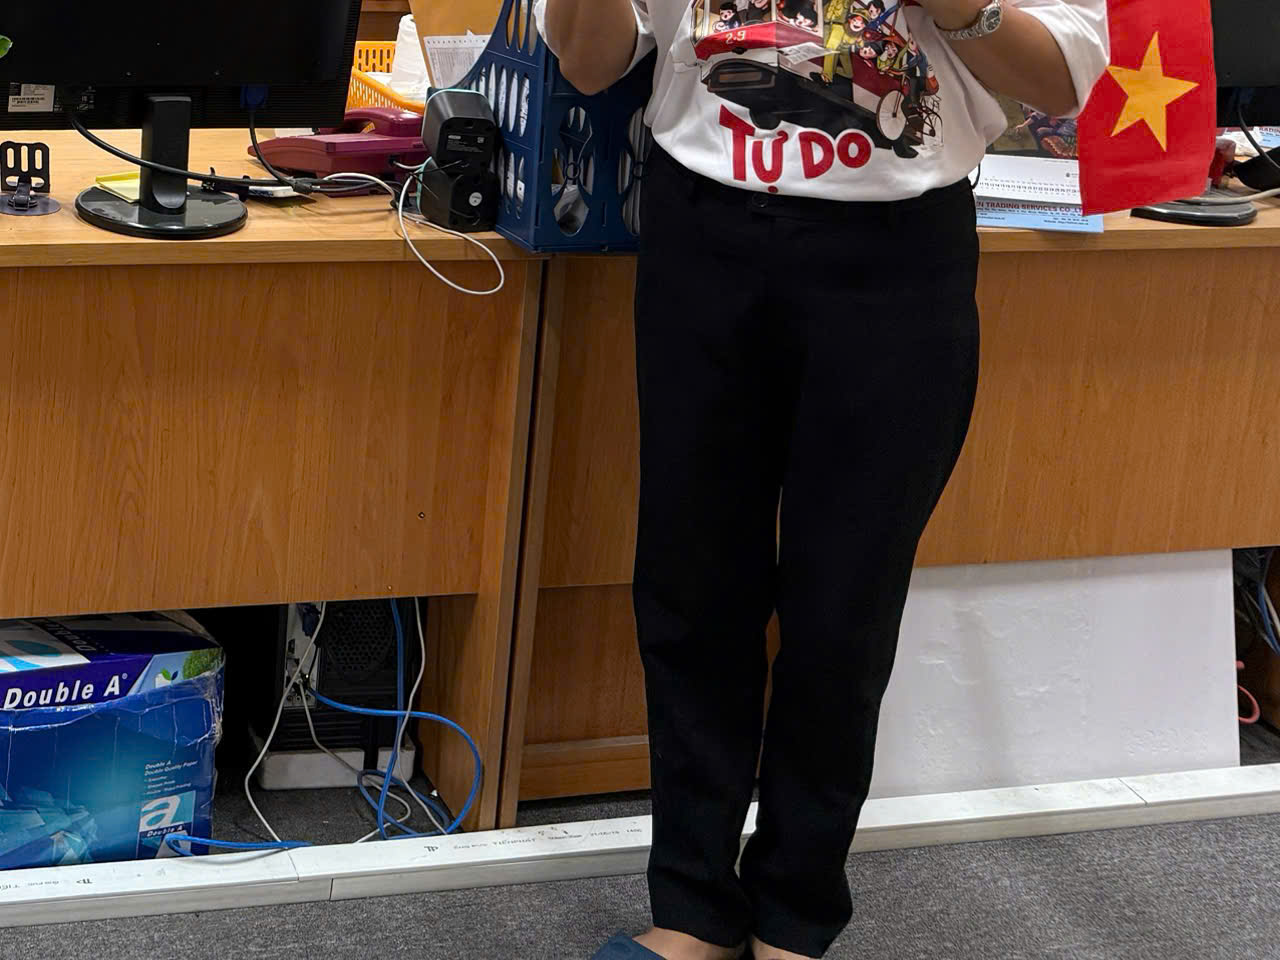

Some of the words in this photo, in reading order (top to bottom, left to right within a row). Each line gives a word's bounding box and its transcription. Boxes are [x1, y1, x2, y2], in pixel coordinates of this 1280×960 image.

[719, 104, 788, 193] TỰ
[798, 131, 872, 179] DO
[986, 202, 1020, 210] TRADING
[1021, 204, 1057, 212] SERVICES
[3, 681, 94, 710] Double
[103, 675, 121, 696] A
